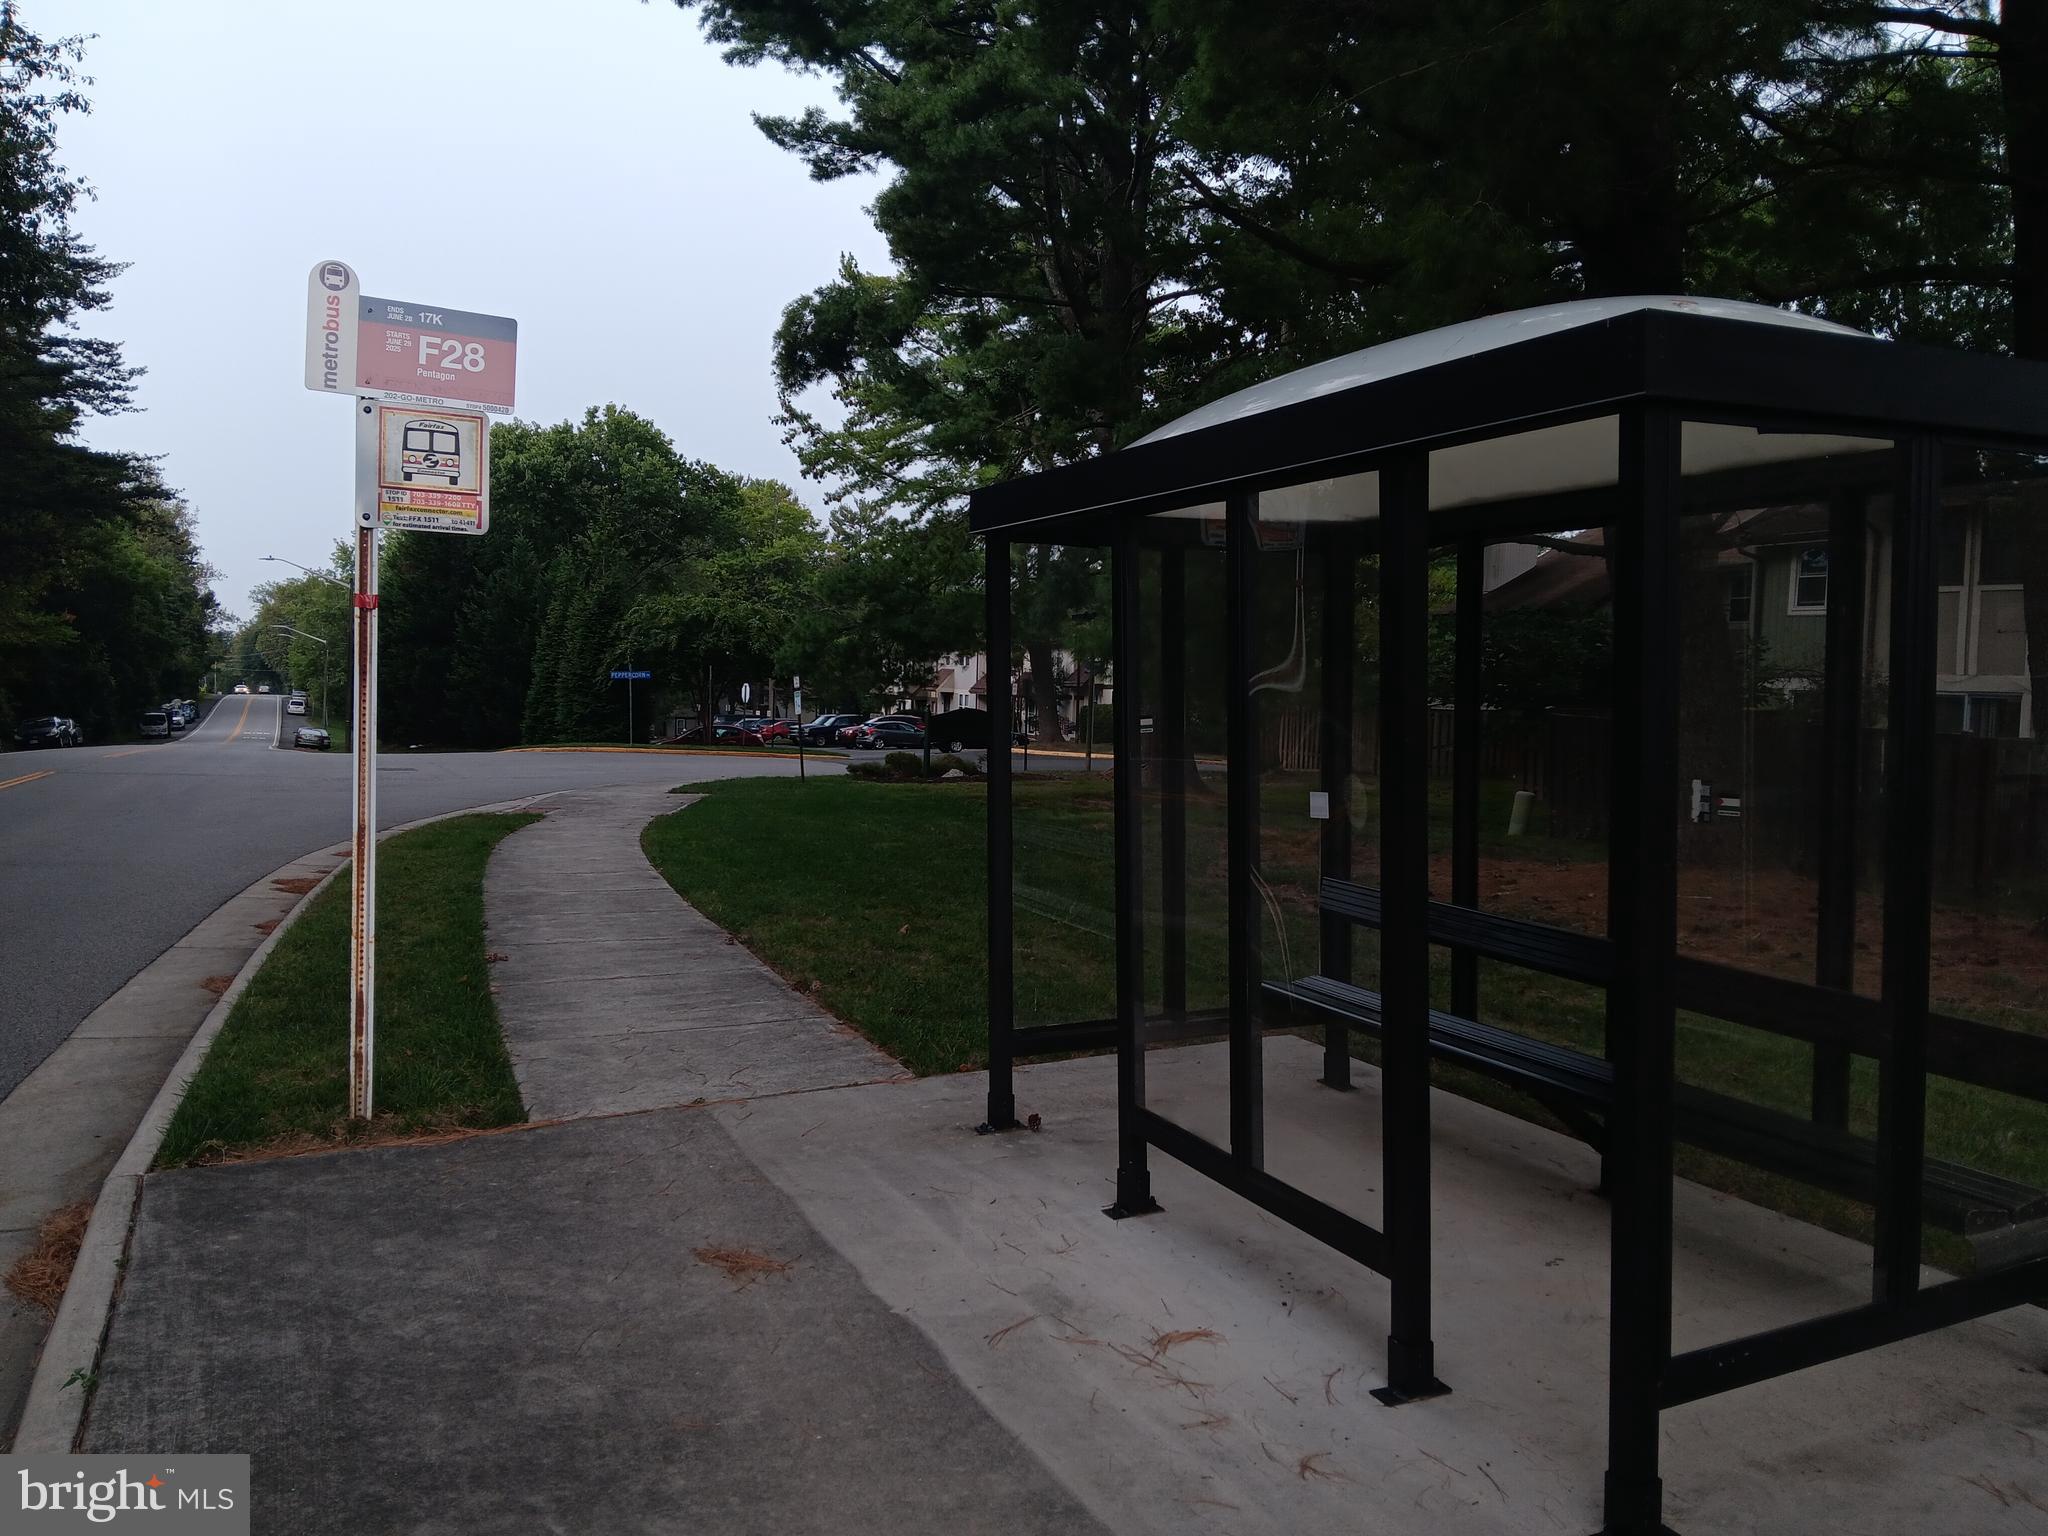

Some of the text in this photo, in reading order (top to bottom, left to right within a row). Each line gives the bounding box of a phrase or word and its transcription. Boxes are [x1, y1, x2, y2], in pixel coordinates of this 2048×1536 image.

[387, 305, 405, 314] ENDS
[386, 312, 404, 321] JUNE
[418, 312, 443, 326] 17K
[385, 330, 411, 340] STARTS
[322, 295, 340, 390] metrobus
[385, 338, 403, 346] JUNE
[385, 345, 402, 353] 2025
[418, 335, 486, 372] F28
[416, 367, 456, 381] Pentagon
[384, 392, 444, 405] 202-GO-METRO
[418, 422, 446, 430] Fairfax
[395, 505, 463, 516] fairfaxconnector.com
[423, 516, 440, 524] 1511
[402, 522, 431, 530] estimated
